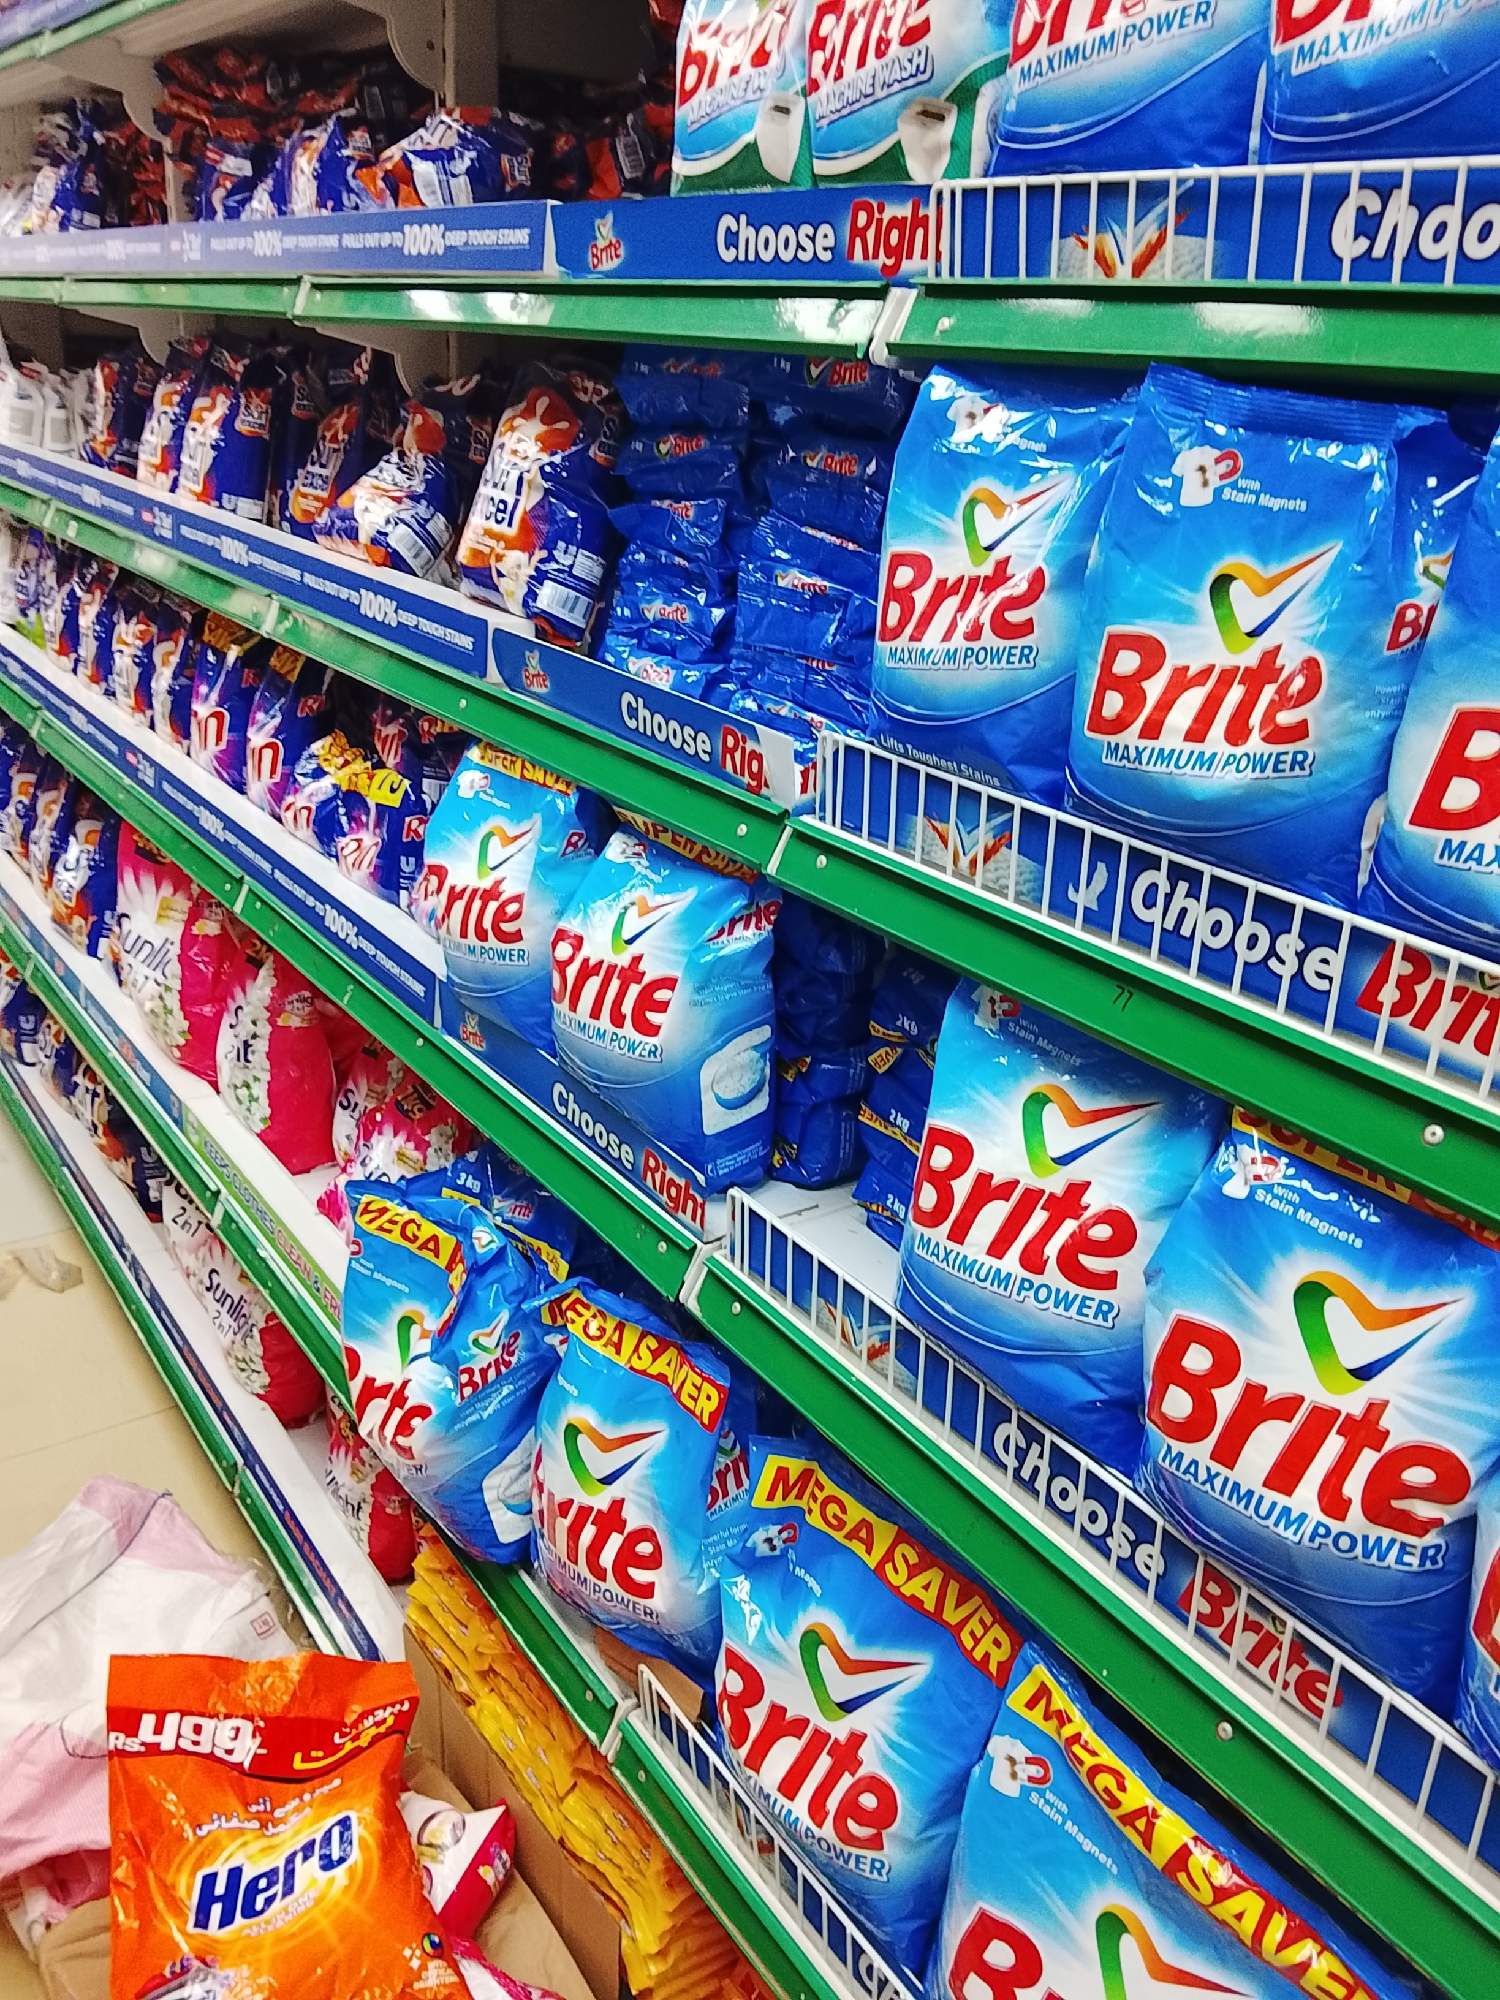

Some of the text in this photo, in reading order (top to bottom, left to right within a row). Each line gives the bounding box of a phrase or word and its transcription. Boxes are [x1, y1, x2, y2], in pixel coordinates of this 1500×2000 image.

[1019, 33, 1117, 87] MAXIMUM
[1122, 3, 1211, 47] POWER
[815, 67, 876, 120] MACHINE
[877, 45, 930, 90] WASH
[403, 223, 445, 256] 100%
[590, 238, 621, 271] Brite
[717, 214, 836, 263] Choose
[828, 360, 868, 386] Brite
[823, 454, 859, 476] Brite
[1237, 477, 1260, 492] With
[1221, 487, 1307, 512] Stain Magnets
[359, 588, 398, 628] 100%
[879, 551, 1046, 643] Brite
[524, 669, 549, 690] Brite
[887, 645, 1035, 666] MAXIMUM POWER
[1087, 632, 1323, 747] Brite
[620, 691, 712, 763] Choose
[880, 733, 1002, 787] Lifts Toughest Stains
[1105, 742, 1310, 774] MAXIMUM POWER
[324, 903, 359, 951] 100%
[479, 946, 527, 965] POWER
[1131, 868, 1340, 992] Choose
[551, 926, 680, 1038] Brite
[461, 1023, 485, 1048] Brite
[555, 1010, 659, 1060] MAXIMUM POWER
[1008, 1021, 1082, 1067] Stain Magnets
[552, 1083, 634, 1171] Choose
[912, 1123, 1138, 1291] Brite
[1254, 1188, 1364, 1249] Stain Magnets
[1273, 1183, 1300, 1205] With
[231, 1172, 276, 1236] CLOTHES
[275, 1229, 313, 1283] CLEAN
[312, 1272, 323, 1295] &
[917, 1233, 1116, 1324] MAXIMUM POWER
[458, 1330, 521, 1406] Brite
[629, 1335, 720, 1427] SAVER
[1147, 1313, 1472, 1539] Brite
[1161, 1444, 1448, 1570] MAXIMUM POWER
[766, 1465, 876, 1556] MEGA
[885, 1543, 1013, 1678] SAVER
[993, 1420, 1344, 1720] Choose Brite
[592, 1581, 661, 1627] POWER
[107, 1731, 146, 1753] Rs.
[718, 1642, 899, 1851] Brite
[1024, 1681, 1158, 1853] MEGA
[1044, 1788, 1069, 1814] With
[803, 1824, 887, 1879] POWER
[1028, 1791, 1119, 1876] Stain Magnets
[193, 1815, 353, 1931] Hero
